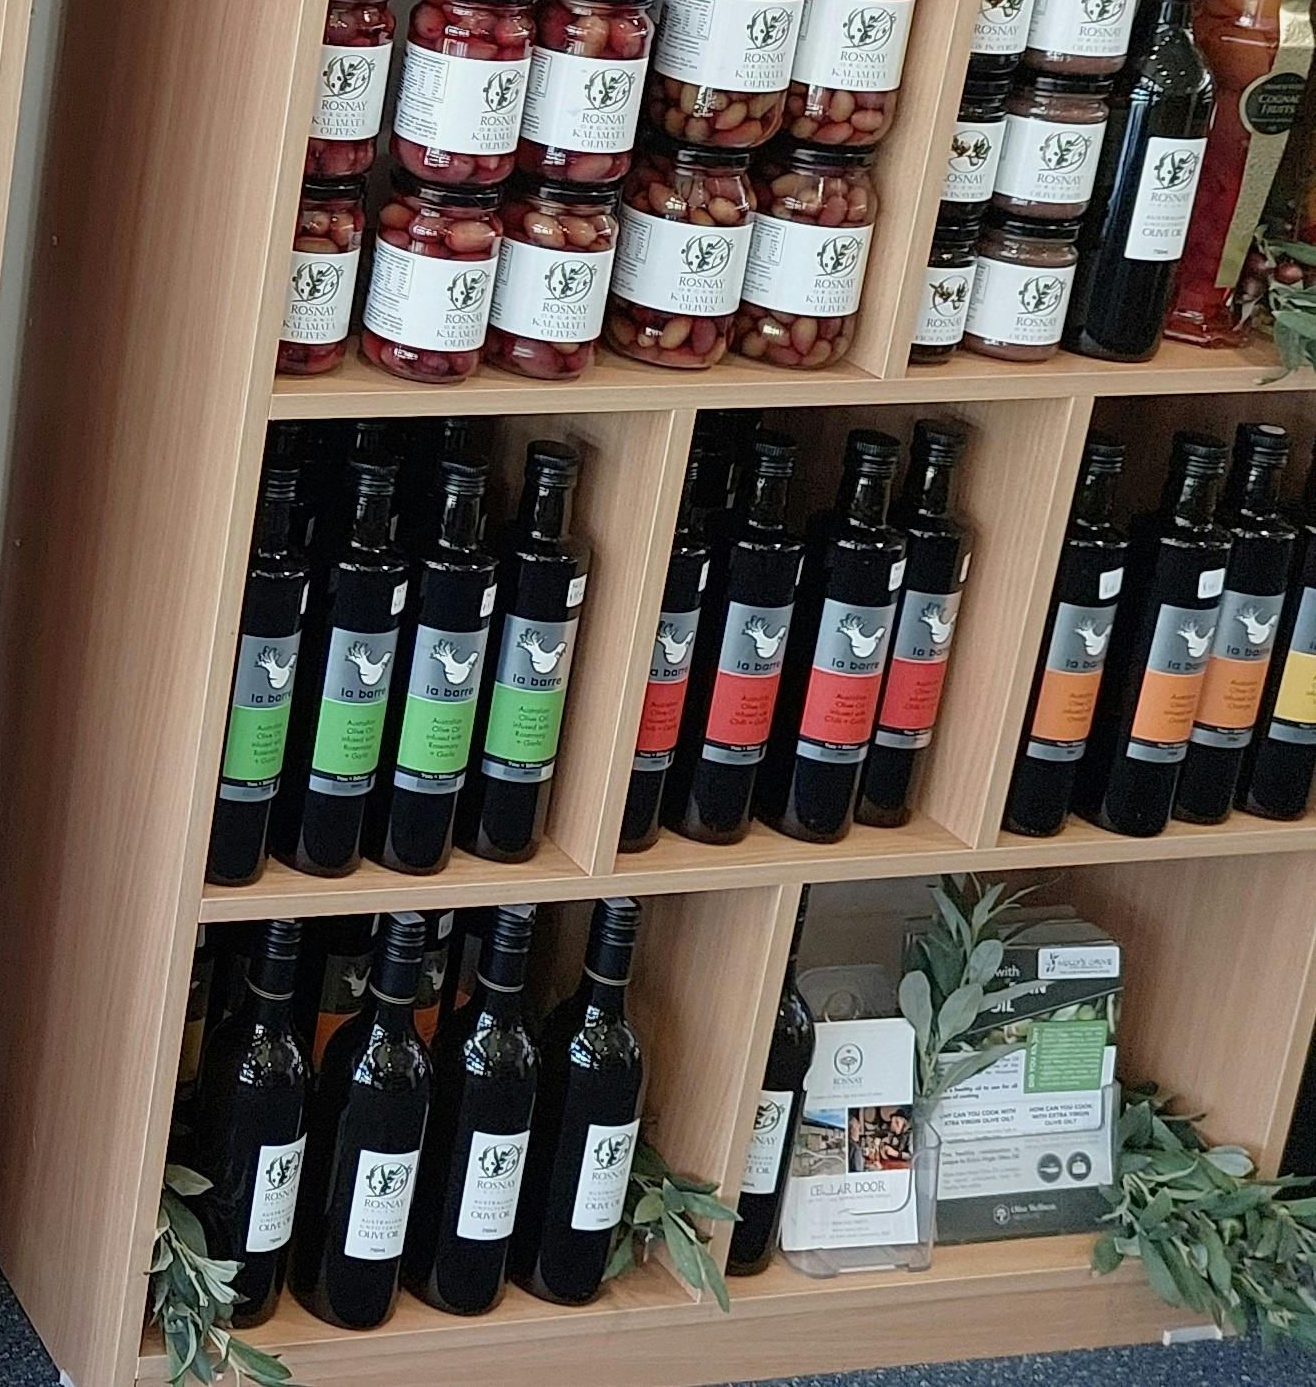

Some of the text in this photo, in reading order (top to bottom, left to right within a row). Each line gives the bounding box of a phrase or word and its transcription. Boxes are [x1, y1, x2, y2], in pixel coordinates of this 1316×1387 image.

[320, 100, 367, 112] ROSNAY
[310, 116, 365, 127] KALAMATA
[581, 112, 626, 125] ROSNAY
[319, 126, 359, 137] OLIVES
[678, 277, 726, 289] ROSNAY
[669, 294, 726, 306] KALAMATA
[679, 302, 716, 314] OLIVES
[512, 672, 562, 687] la barre
[995, 966, 1020, 978] with
[855, 1180, 886, 1194] DOOR
[364, 1198, 406, 1209] ROSNAY
[357, 1230, 399, 1241] OLIVE OIL
